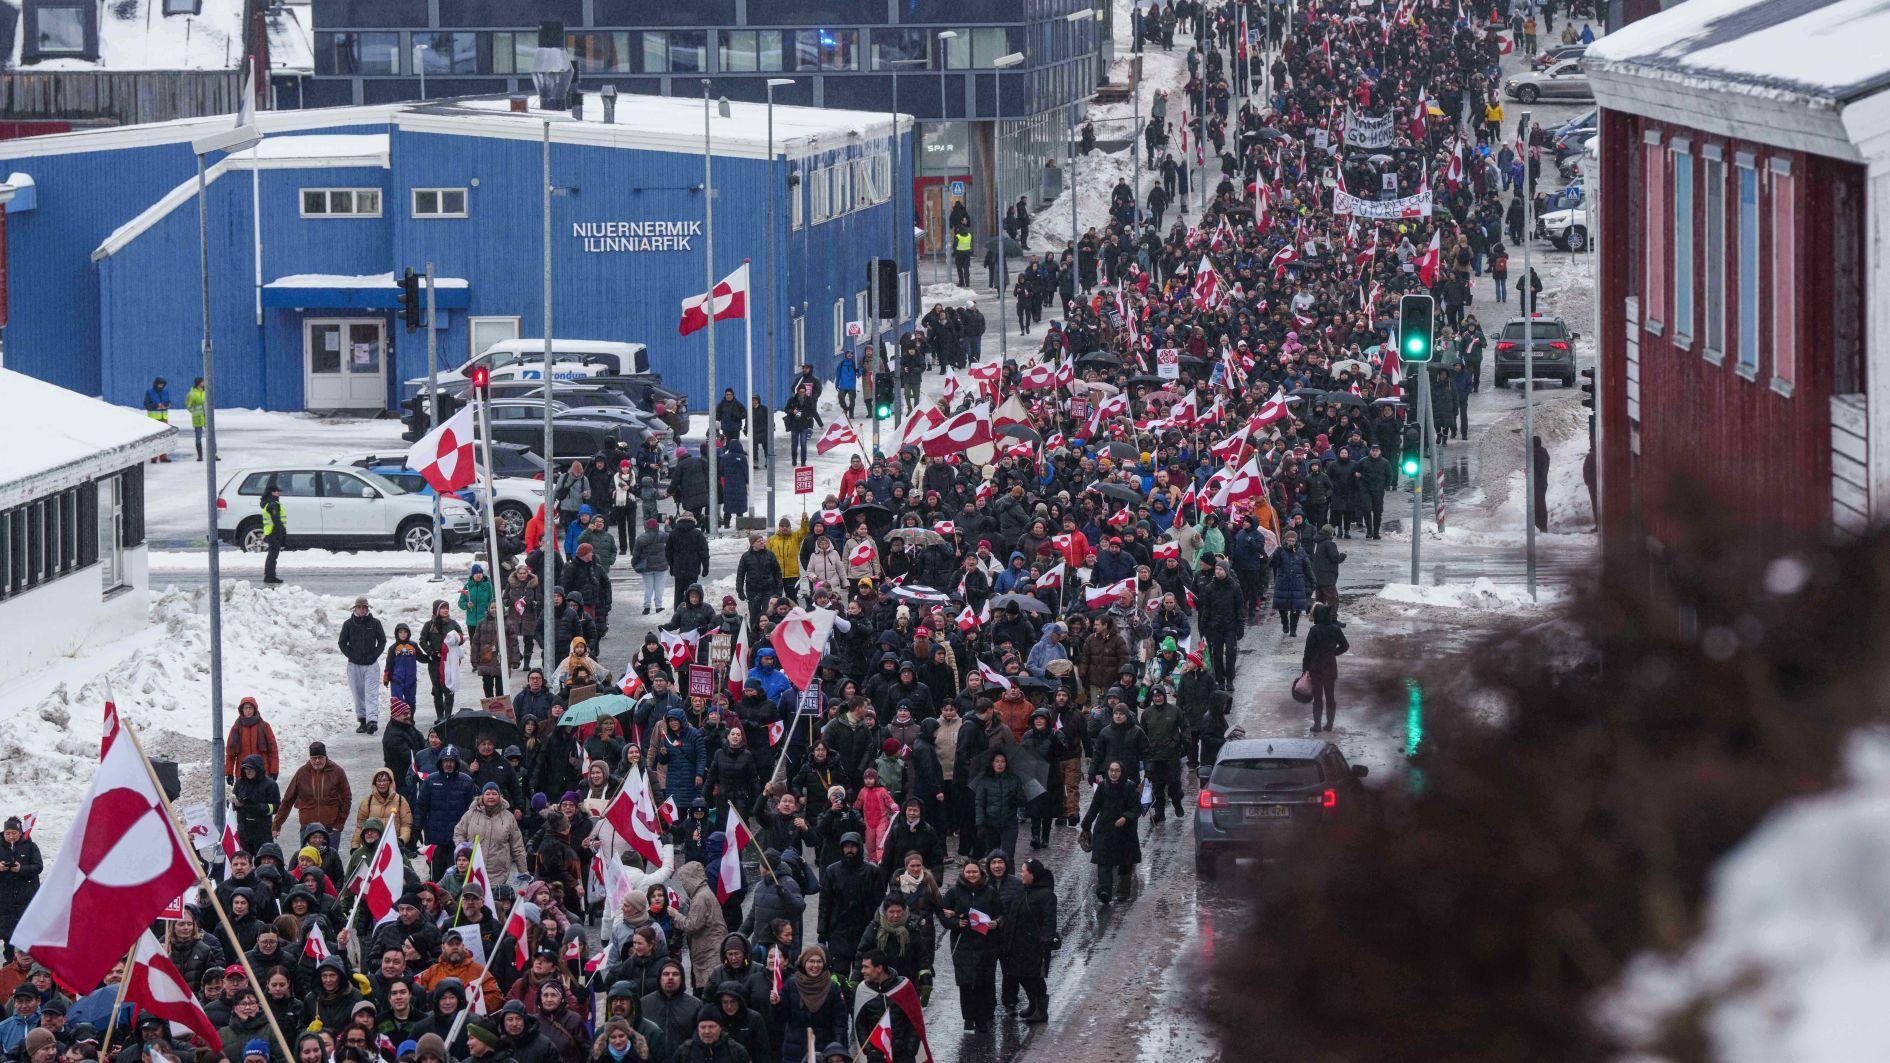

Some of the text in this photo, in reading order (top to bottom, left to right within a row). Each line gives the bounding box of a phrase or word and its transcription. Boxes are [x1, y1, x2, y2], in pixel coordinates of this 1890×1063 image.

[1355, 115, 1392, 129] YANKEE
[1348, 129, 1366, 143] GO
[927, 144, 954, 152] SPAR
[1409, 192, 1431, 204] OUR
[1351, 204, 1400, 217] FUTURE
[573, 221, 702, 237] NIUERNERMIK
[584, 236, 691, 252] ILINNIARFIK
[712, 647, 731, 661] NO!
[691, 683, 711, 695] SALE!
